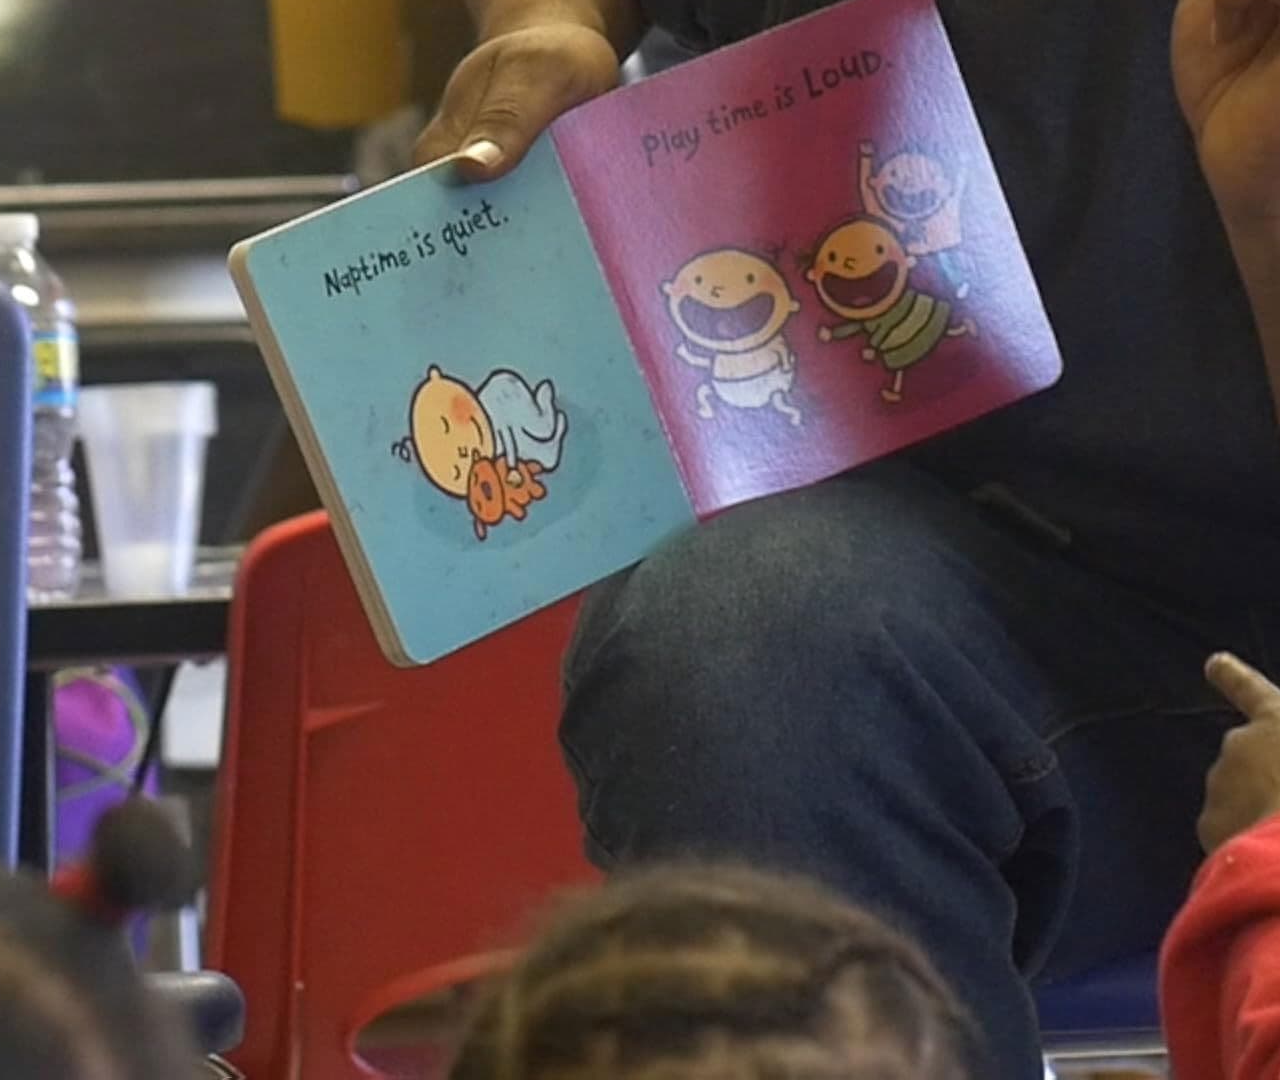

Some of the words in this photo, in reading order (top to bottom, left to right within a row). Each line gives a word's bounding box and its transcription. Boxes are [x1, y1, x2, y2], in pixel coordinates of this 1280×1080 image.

[643, 127, 700, 166] Play
[706, 98, 768, 136] time
[775, 85, 796, 111] is
[324, 248, 411, 298] Naptime
[413, 231, 435, 259] is
[441, 198, 510, 257] quiet.
